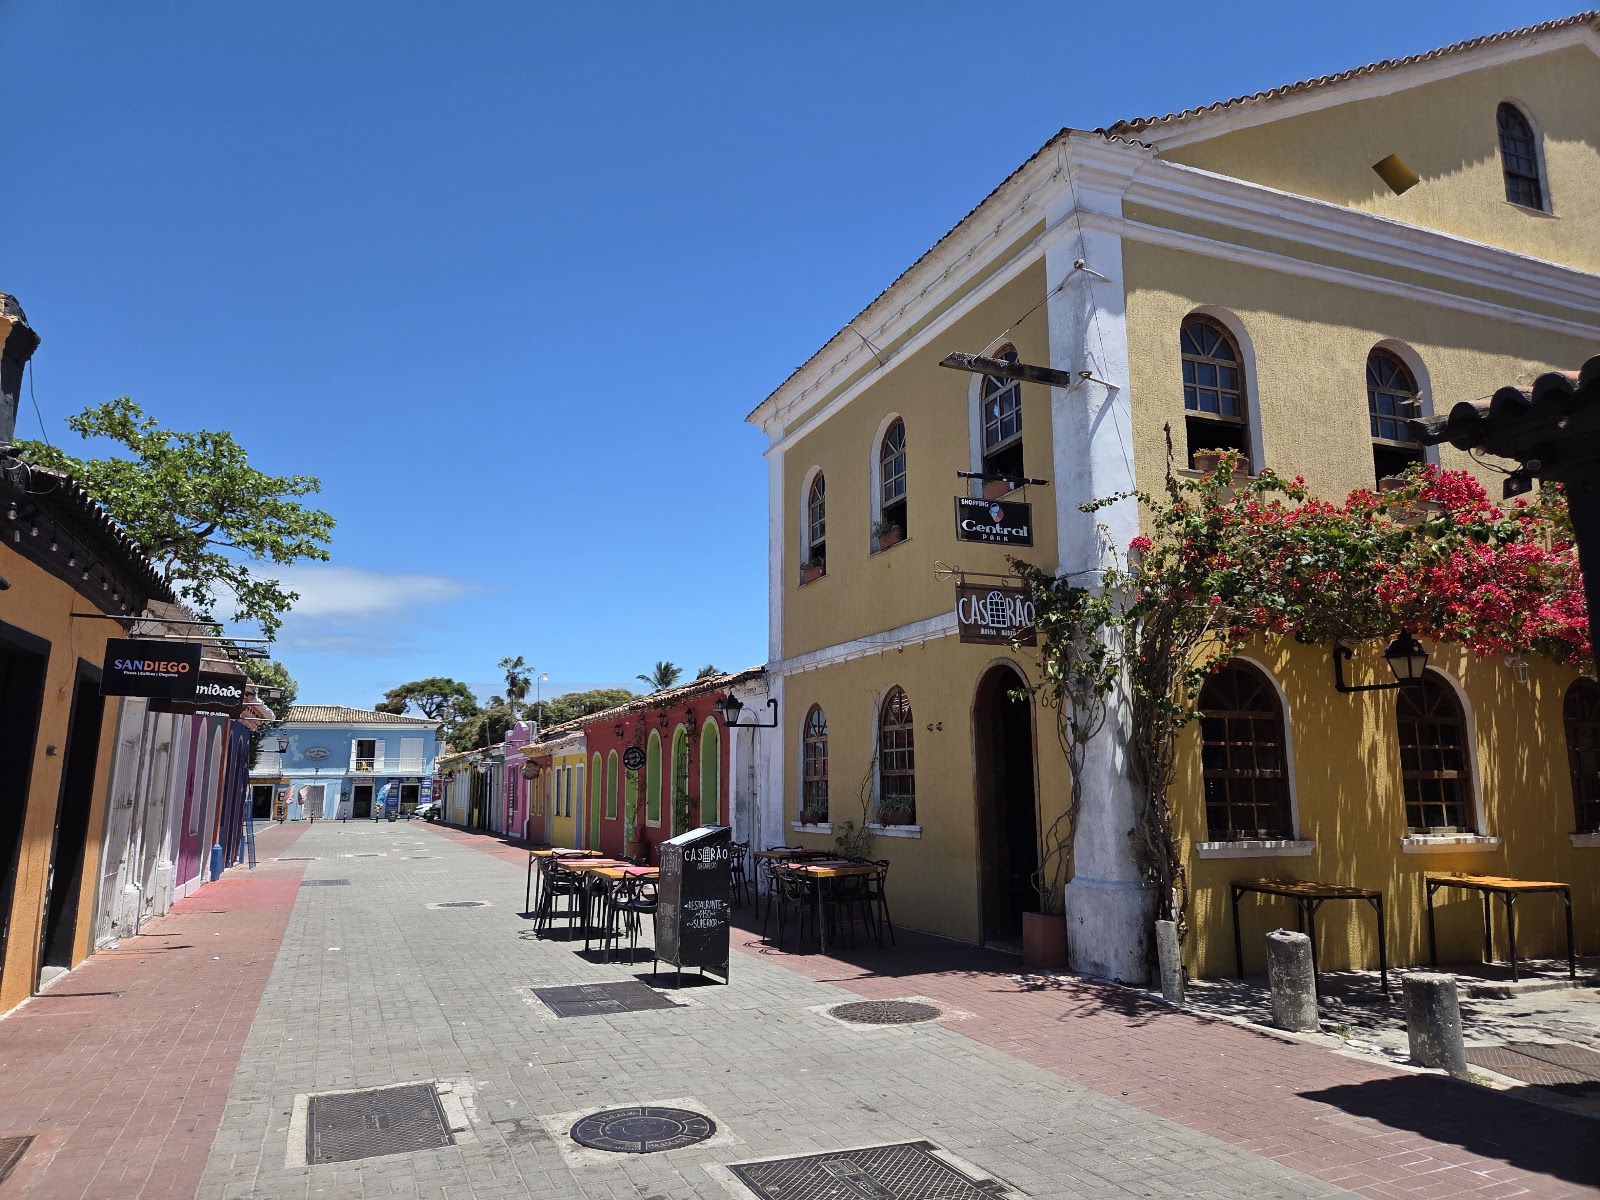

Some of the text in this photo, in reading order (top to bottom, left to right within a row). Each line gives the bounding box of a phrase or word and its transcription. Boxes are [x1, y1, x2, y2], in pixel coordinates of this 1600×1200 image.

[961, 499, 989, 507] SHOPPING
[961, 519, 1028, 537] Central
[688, 899, 722, 911] RESTAURANTE
[692, 919, 718, 929] SUPERIOR
